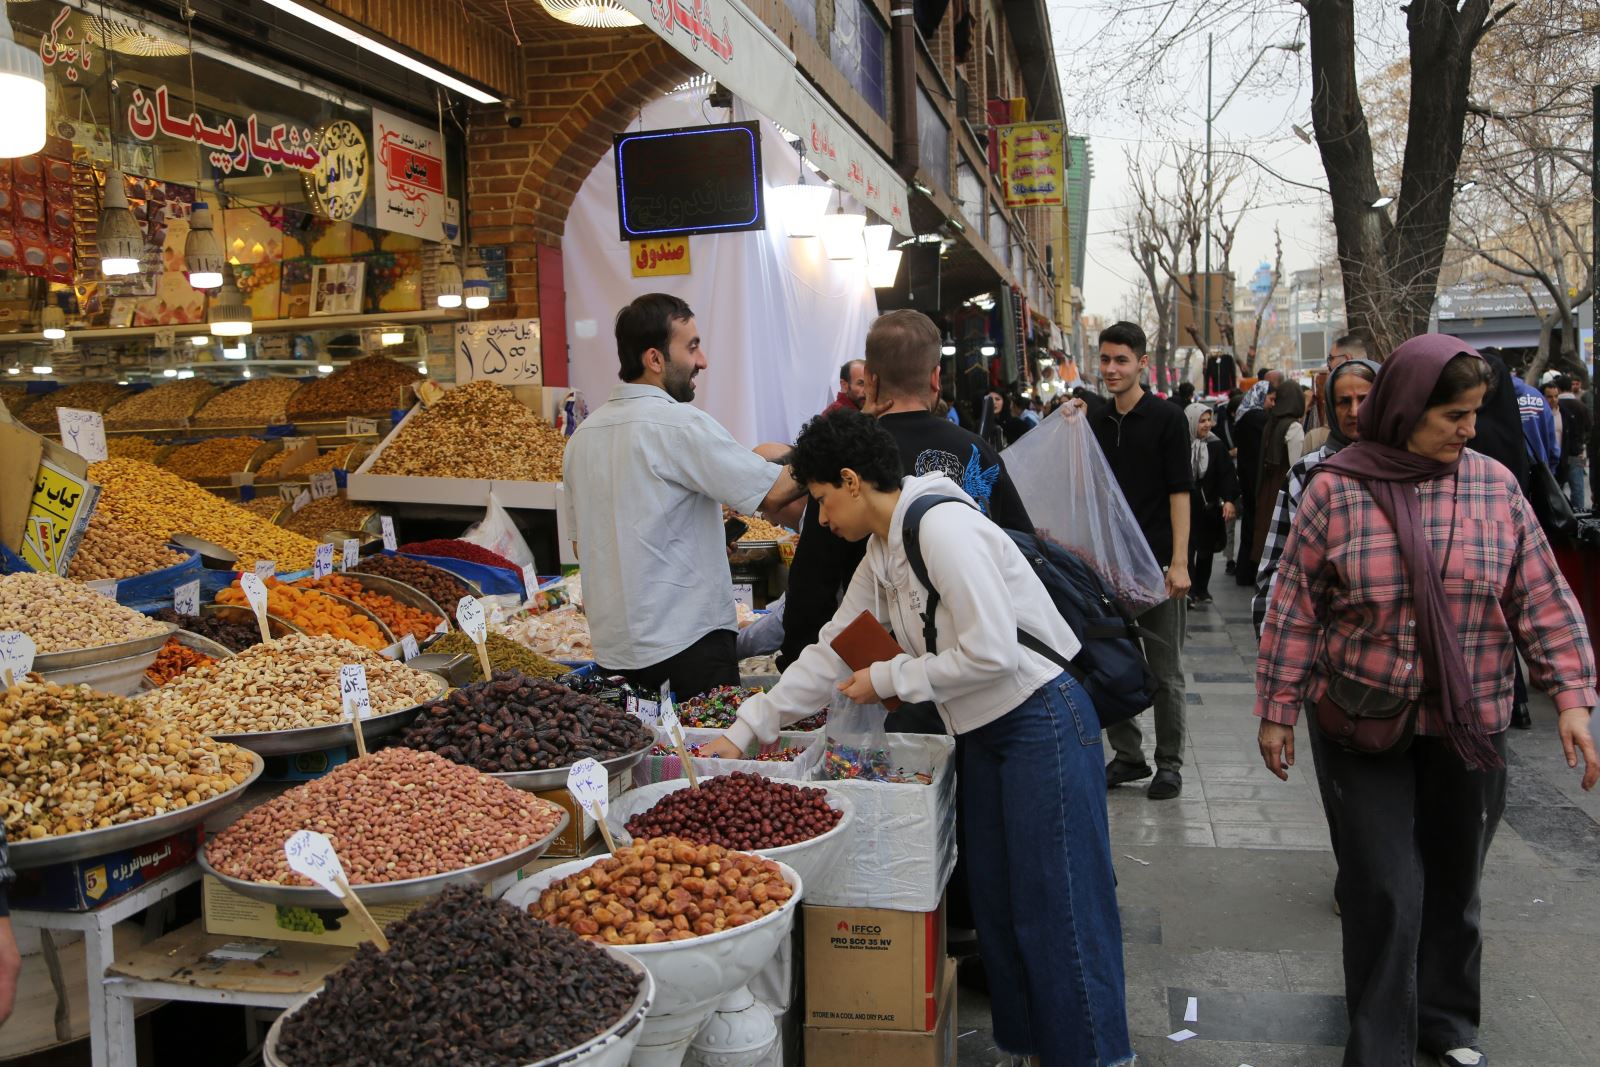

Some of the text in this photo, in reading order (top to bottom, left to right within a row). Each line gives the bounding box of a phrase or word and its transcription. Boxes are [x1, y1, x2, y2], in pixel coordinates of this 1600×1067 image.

[40, 6, 93, 81] نمایندگی
[128, 85, 321, 178] خشکبار پیمان
[636, 242, 685, 269] صندوق
[1517, 394, 1544, 406] size
[87, 872, 97, 890] 5
[852, 925, 881, 933] IFFCO
